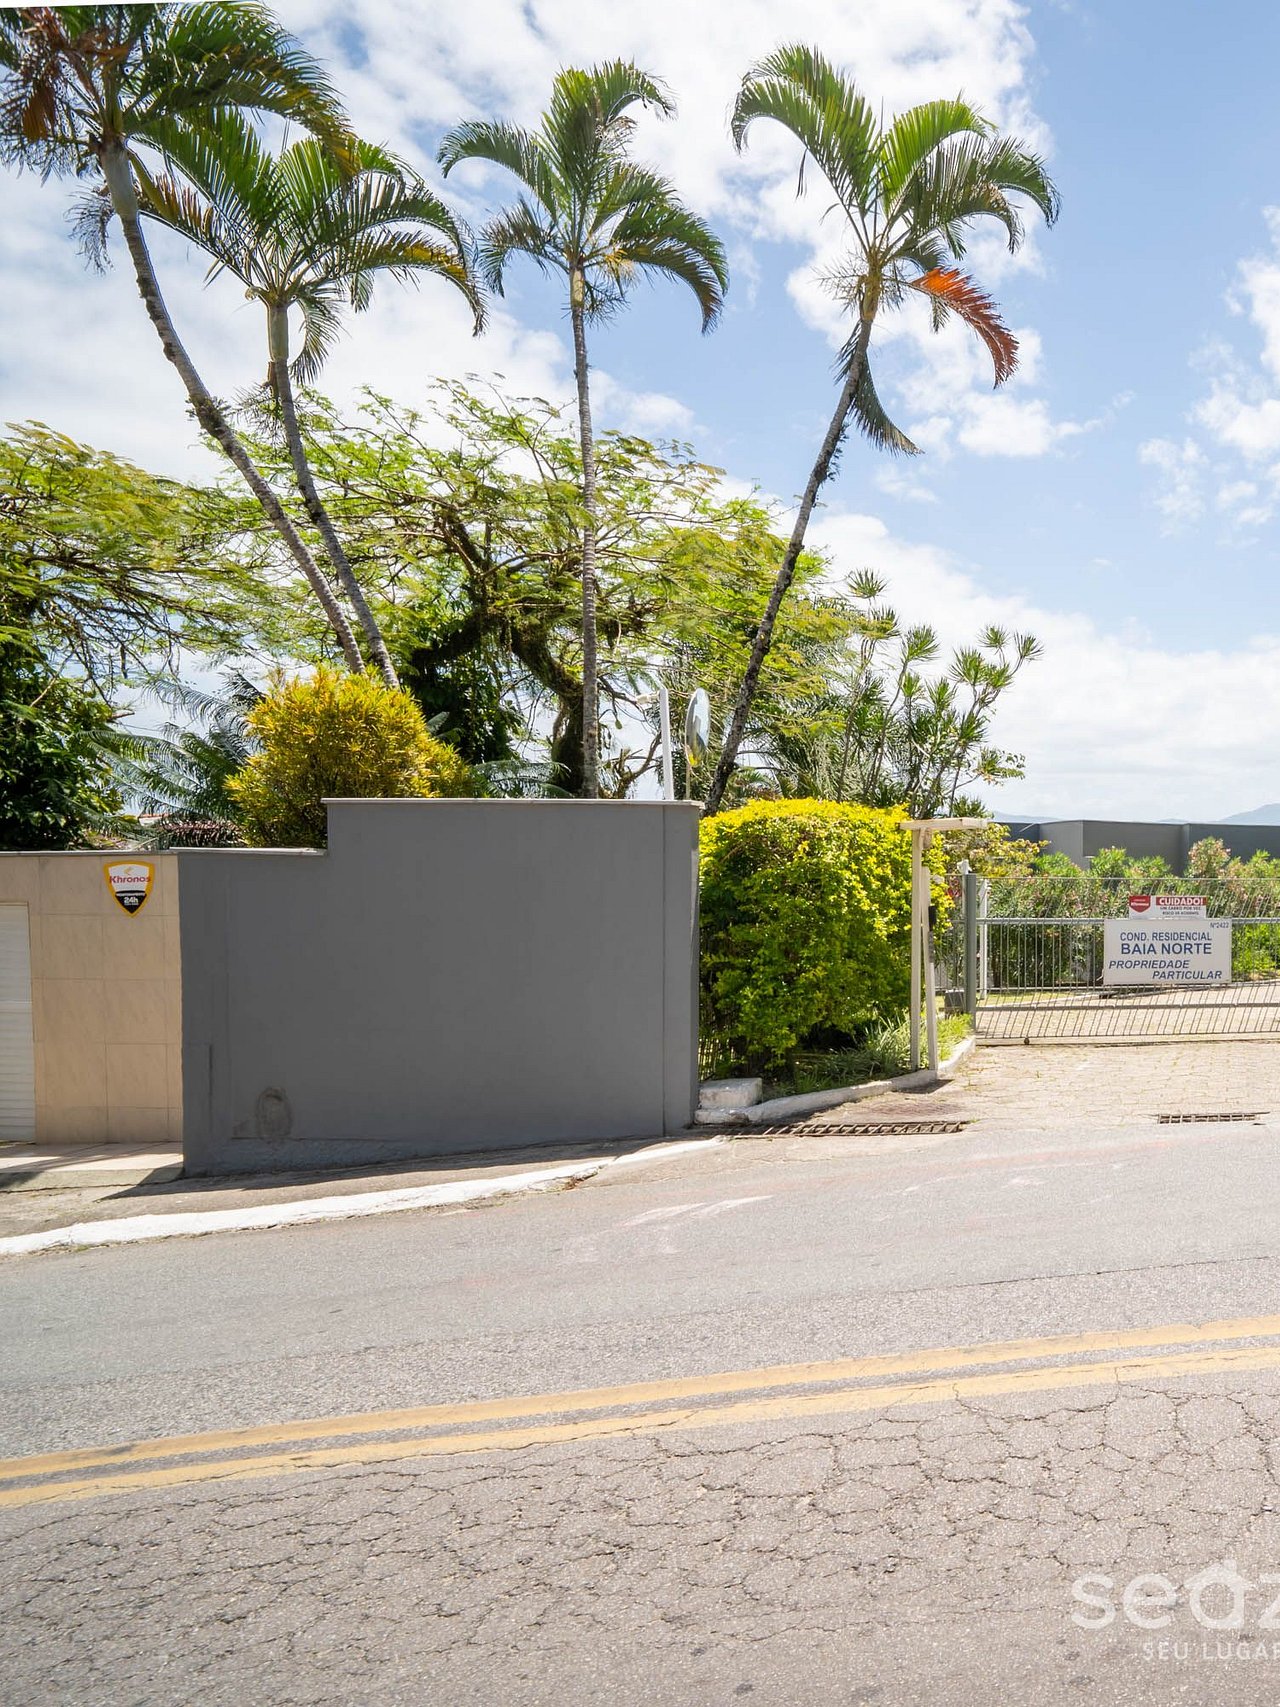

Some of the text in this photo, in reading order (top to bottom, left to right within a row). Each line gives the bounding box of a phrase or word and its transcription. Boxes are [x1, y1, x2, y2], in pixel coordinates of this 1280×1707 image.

[109, 875, 151, 884] Khronos
[1159, 897, 1204, 905] CUIDADO!
[1120, 932, 1212, 941] COND. RESIDENCIAL
[1121, 943, 1212, 955] BAIA NORTE
[1109, 960, 1190, 969] PROPRIEDADE
[1152, 970, 1222, 980] PARTICULAR
